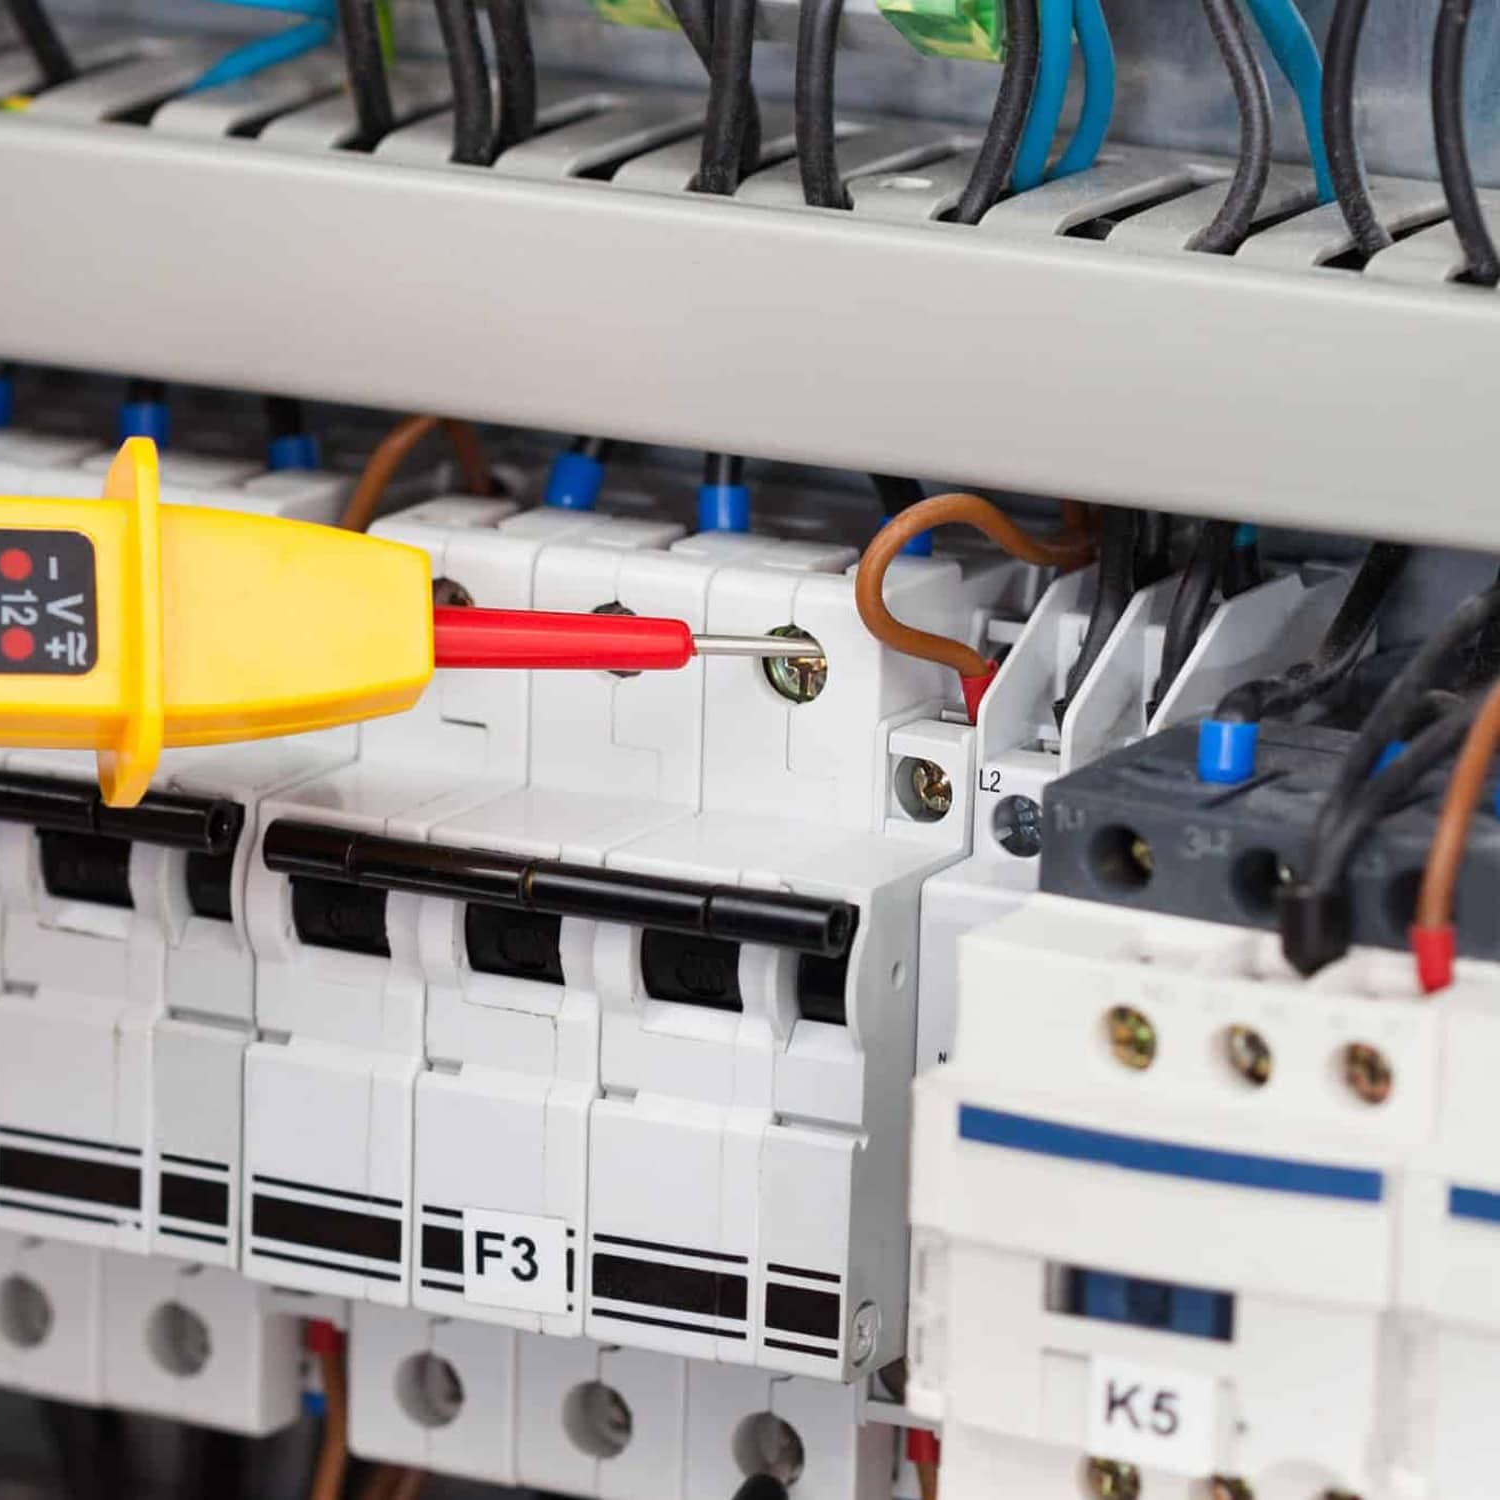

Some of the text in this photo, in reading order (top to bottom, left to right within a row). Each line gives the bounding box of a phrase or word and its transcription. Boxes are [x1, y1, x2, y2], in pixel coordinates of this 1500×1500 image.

[0, 590, 40, 626] 12
[978, 769, 1002, 793] L2
[938, 1051, 947, 1064] N
[473, 1230, 540, 1282] F3
[1104, 1379, 1180, 1437] K5
